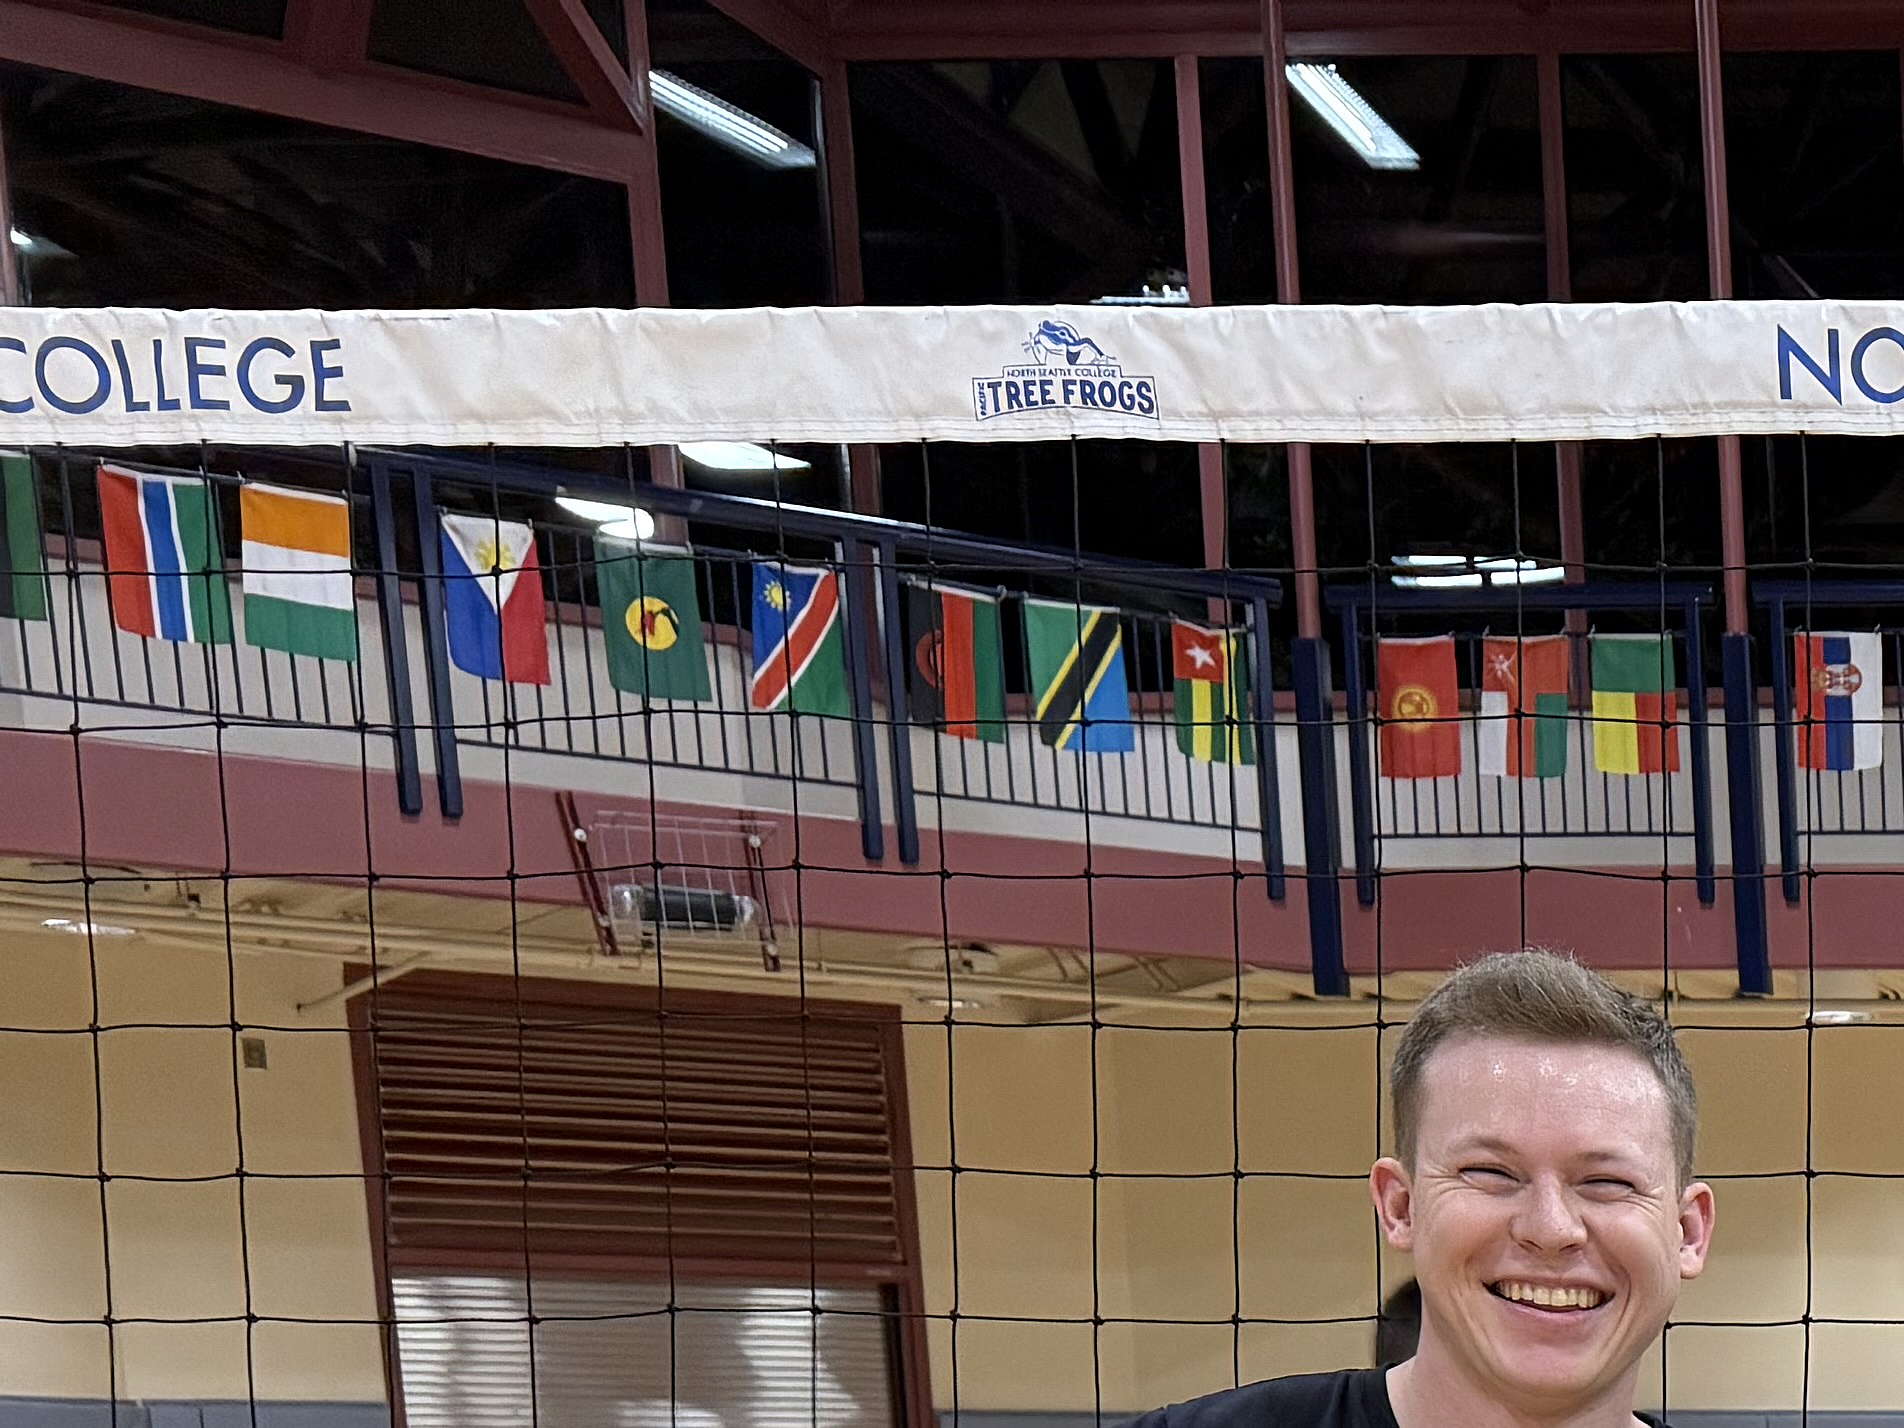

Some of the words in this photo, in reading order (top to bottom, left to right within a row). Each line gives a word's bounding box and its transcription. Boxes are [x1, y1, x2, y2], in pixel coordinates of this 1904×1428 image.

[1006, 367, 1037, 378] NORTH
[1075, 367, 1117, 378] COLLEGE
[987, 379, 1056, 413] TREE
[1062, 379, 1155, 414] FROGS
